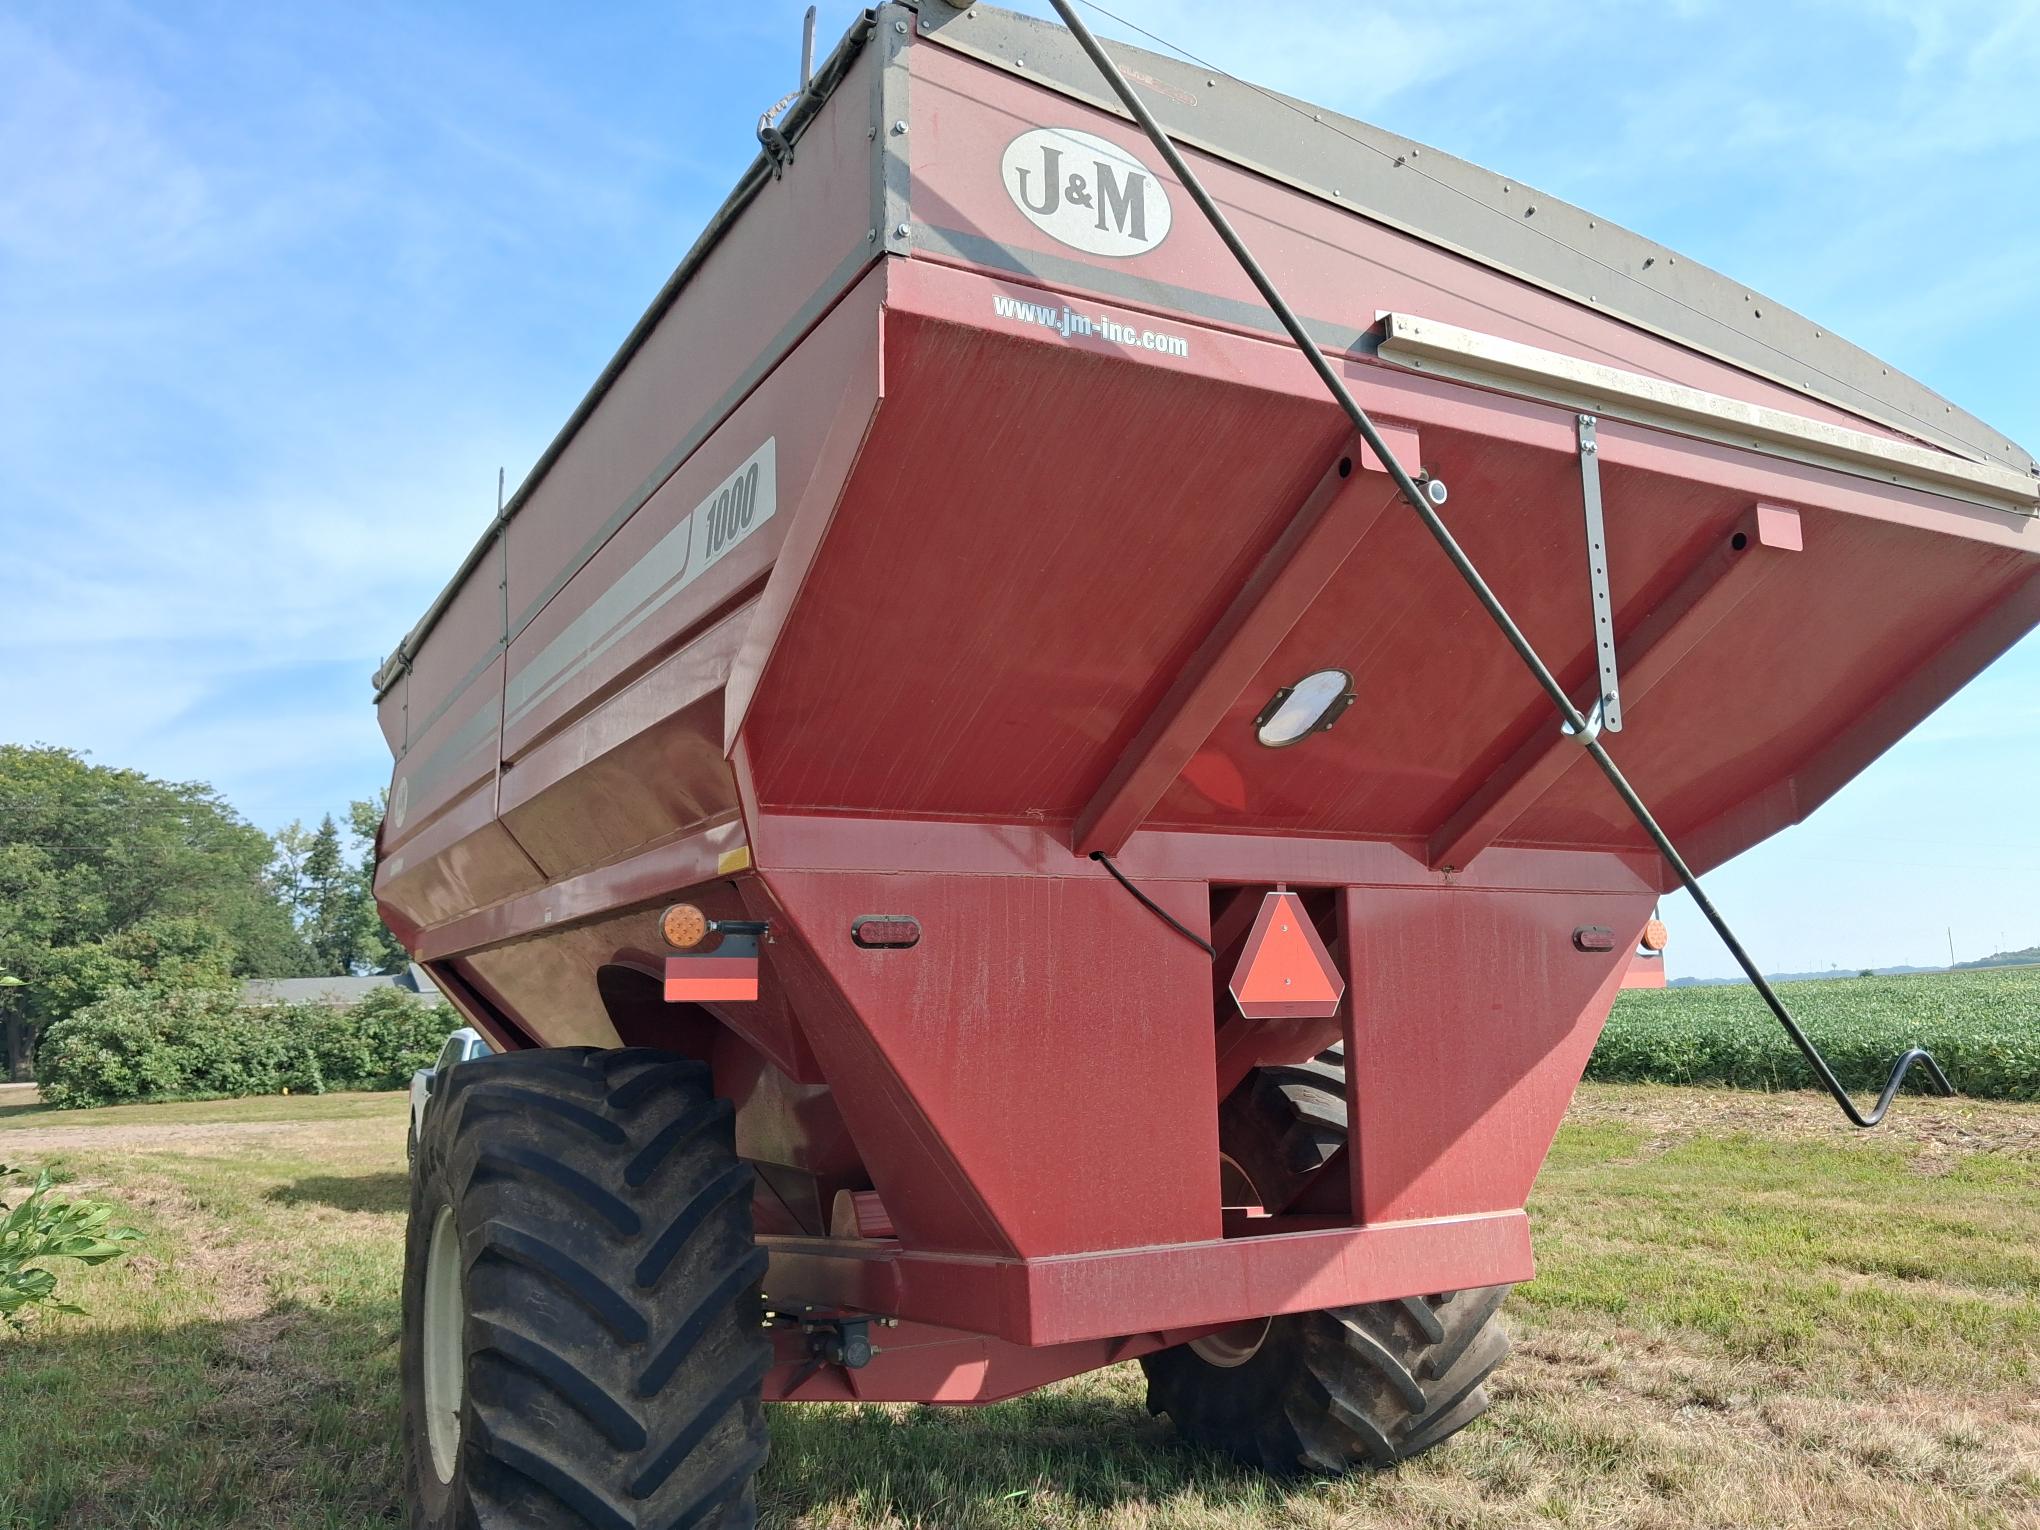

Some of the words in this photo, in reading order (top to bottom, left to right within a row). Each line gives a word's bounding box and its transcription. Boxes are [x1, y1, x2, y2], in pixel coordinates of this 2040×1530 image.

[1015, 145, 1149, 242] J&M
[992, 293, 1189, 358] www.jm-inc.com
[704, 461, 760, 560] 1000
